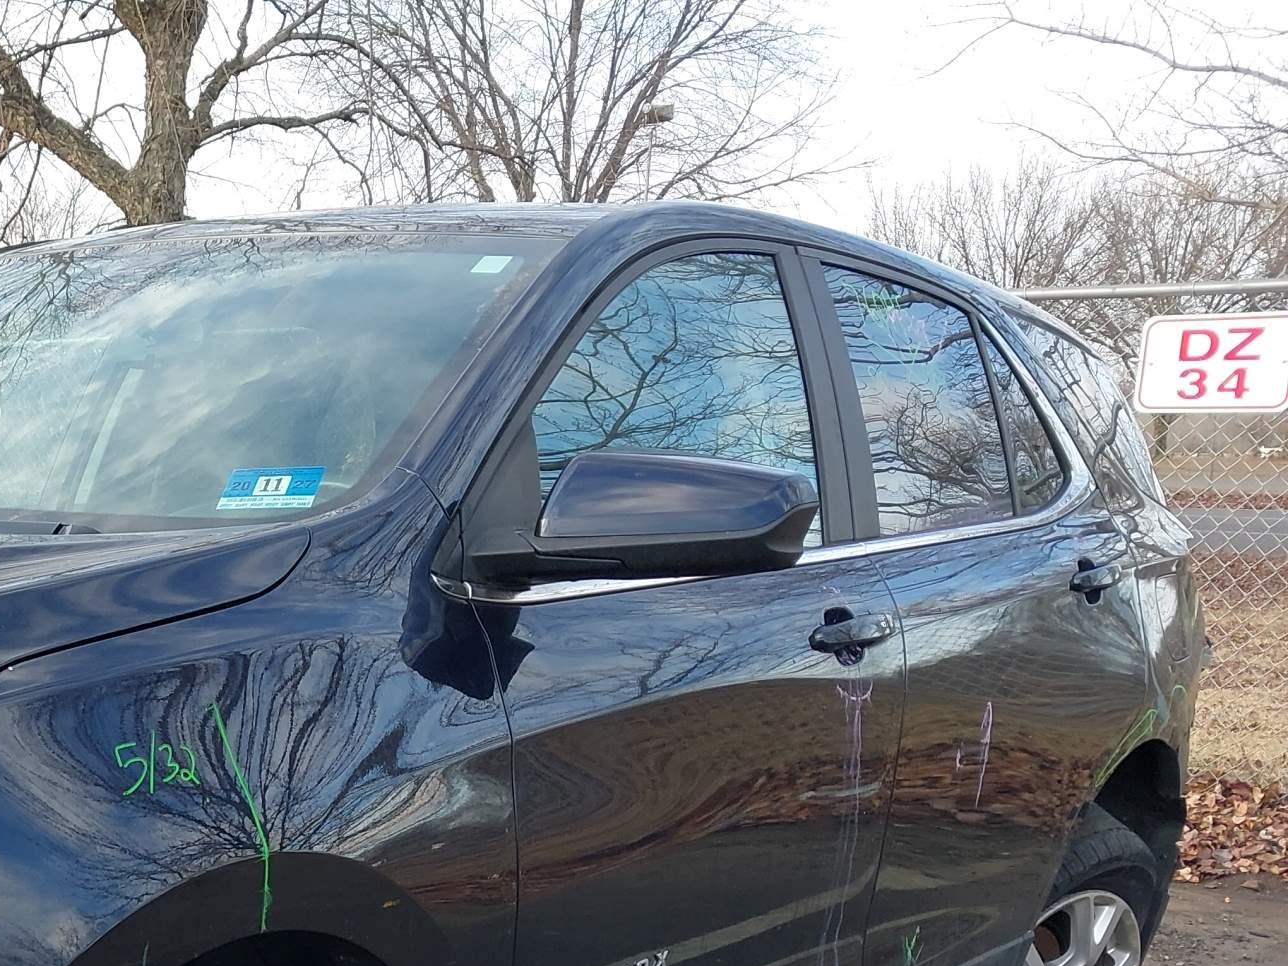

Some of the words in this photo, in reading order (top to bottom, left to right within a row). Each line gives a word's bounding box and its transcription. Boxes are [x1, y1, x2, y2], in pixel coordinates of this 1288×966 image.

[1179, 327, 1265, 361] DZ
[1177, 367, 1249, 400] 34
[231, 480, 252, 491] 20
[259, 478, 283, 492] 11
[115, 730, 201, 796] 5/32
